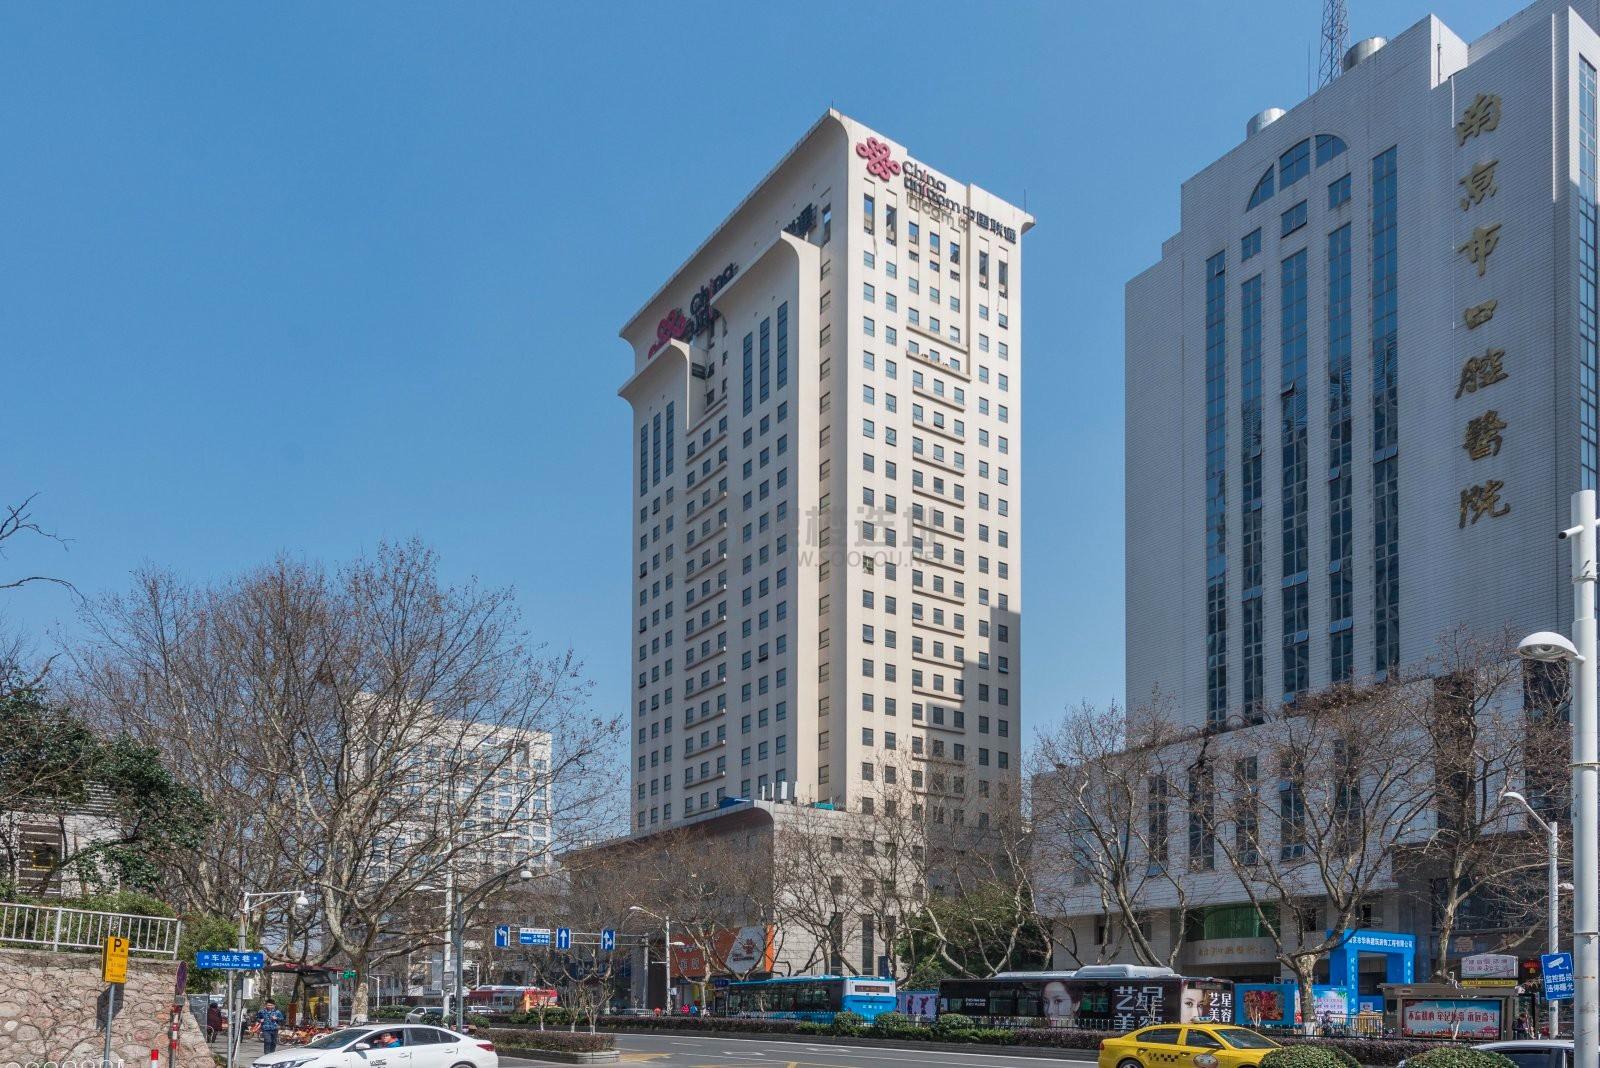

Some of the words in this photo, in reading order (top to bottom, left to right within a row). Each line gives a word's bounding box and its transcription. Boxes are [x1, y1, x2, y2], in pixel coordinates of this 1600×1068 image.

[902, 160, 947, 193] China
[904, 176, 961, 214] unicom
[113, 939, 122, 952] P
[211, 954, 251, 962] 车站东巷
[1114, 986, 1164, 1012] 艺星
[1209, 992, 1232, 1008] 艺星
[1208, 1008, 1232, 1022] 美容
